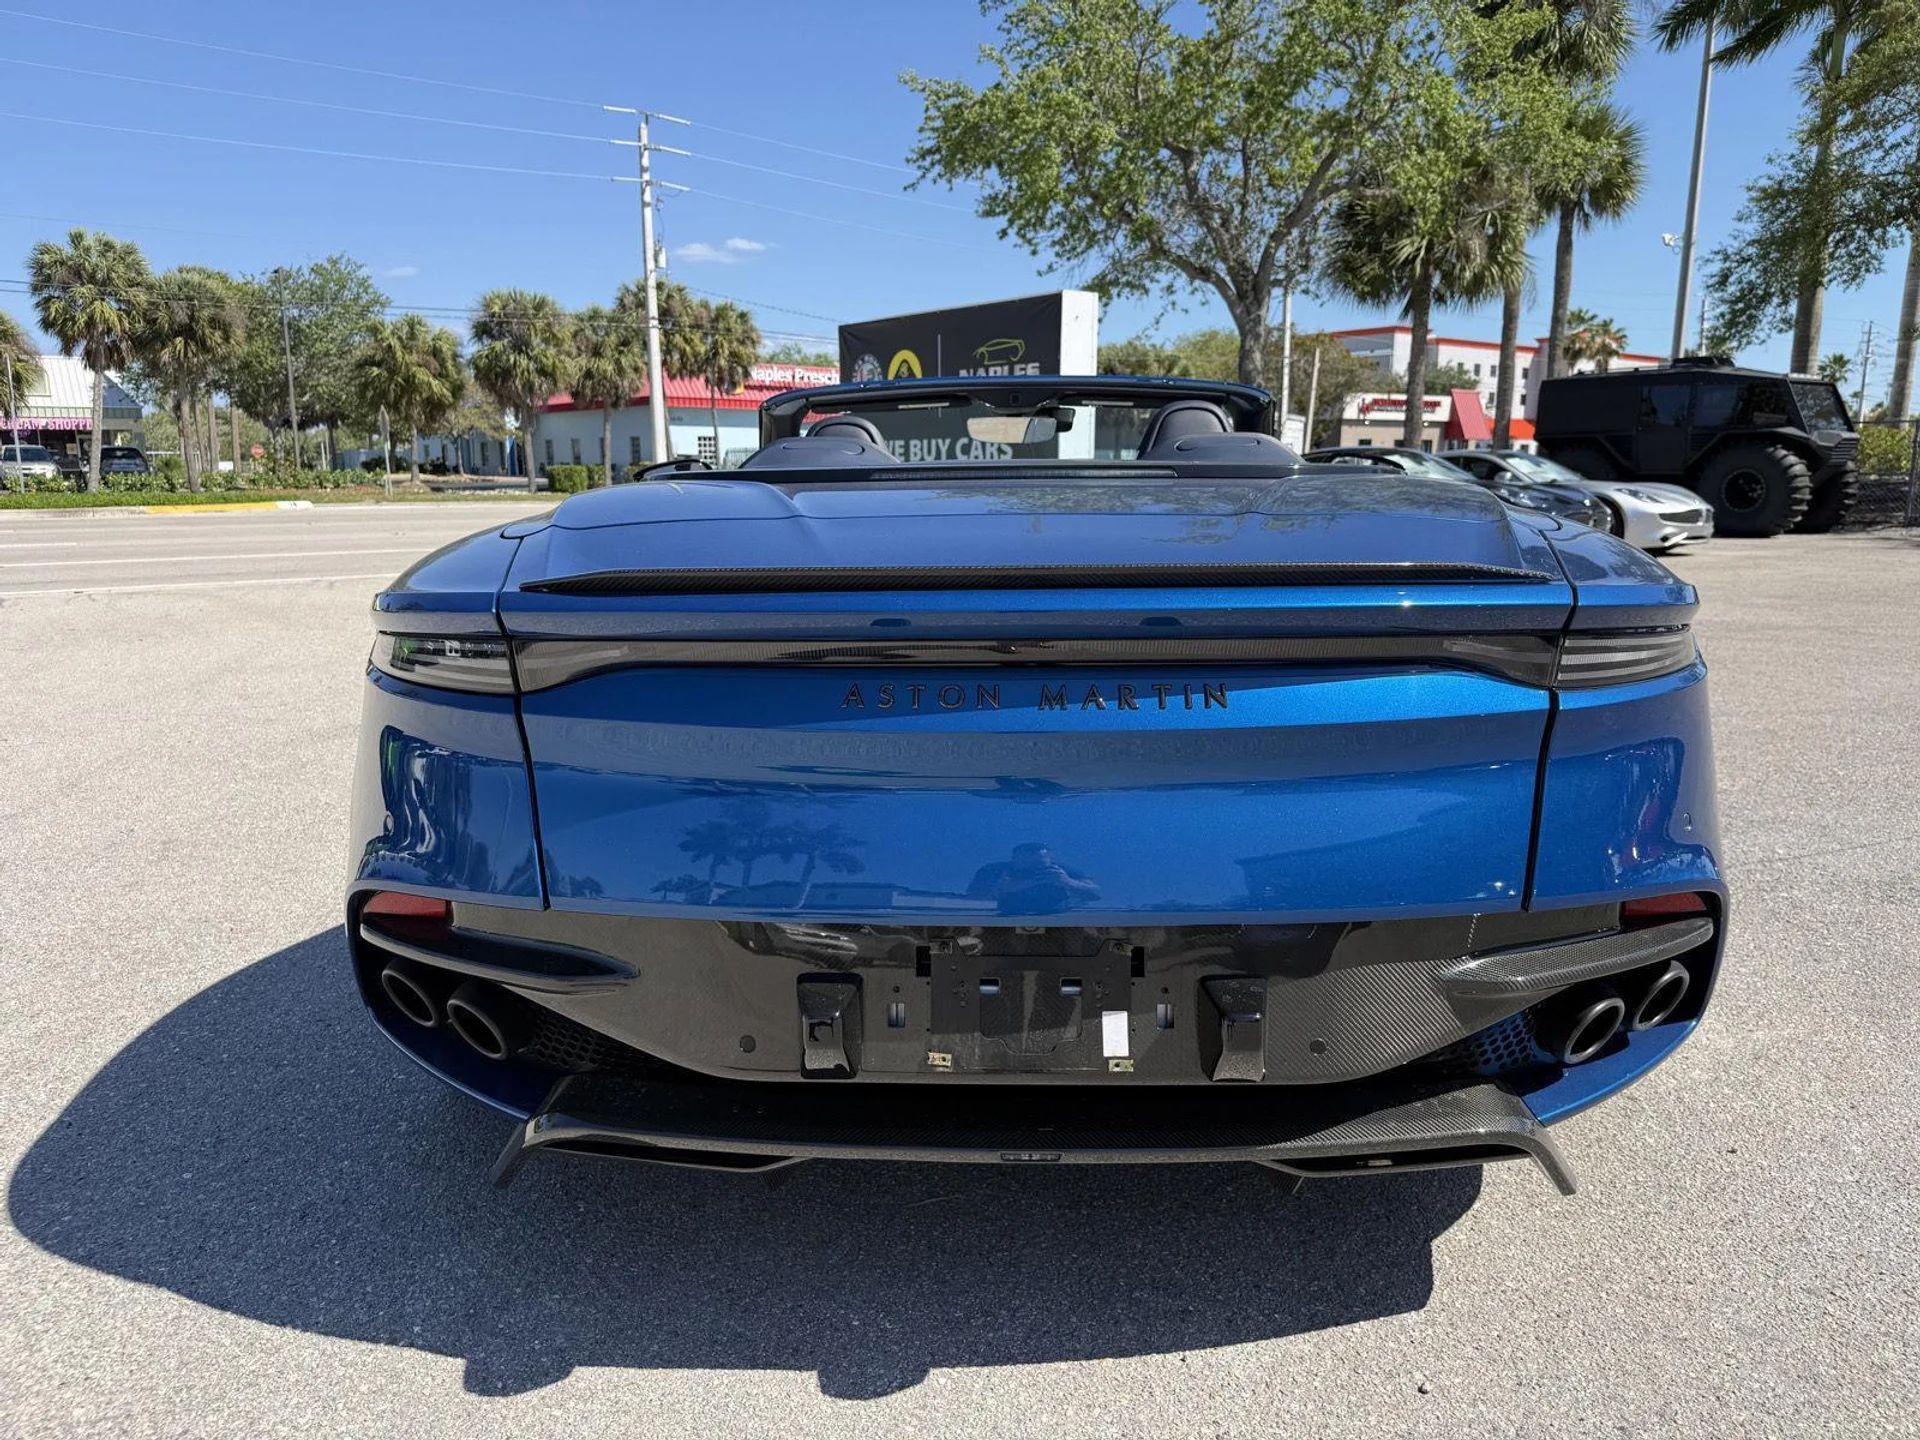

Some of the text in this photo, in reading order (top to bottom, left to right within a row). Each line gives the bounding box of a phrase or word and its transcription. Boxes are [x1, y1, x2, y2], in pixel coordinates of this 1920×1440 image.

[909, 438, 951, 461] BUY
[955, 437, 1013, 461] CARS
[841, 683, 1229, 711] ASTON MARTIN
